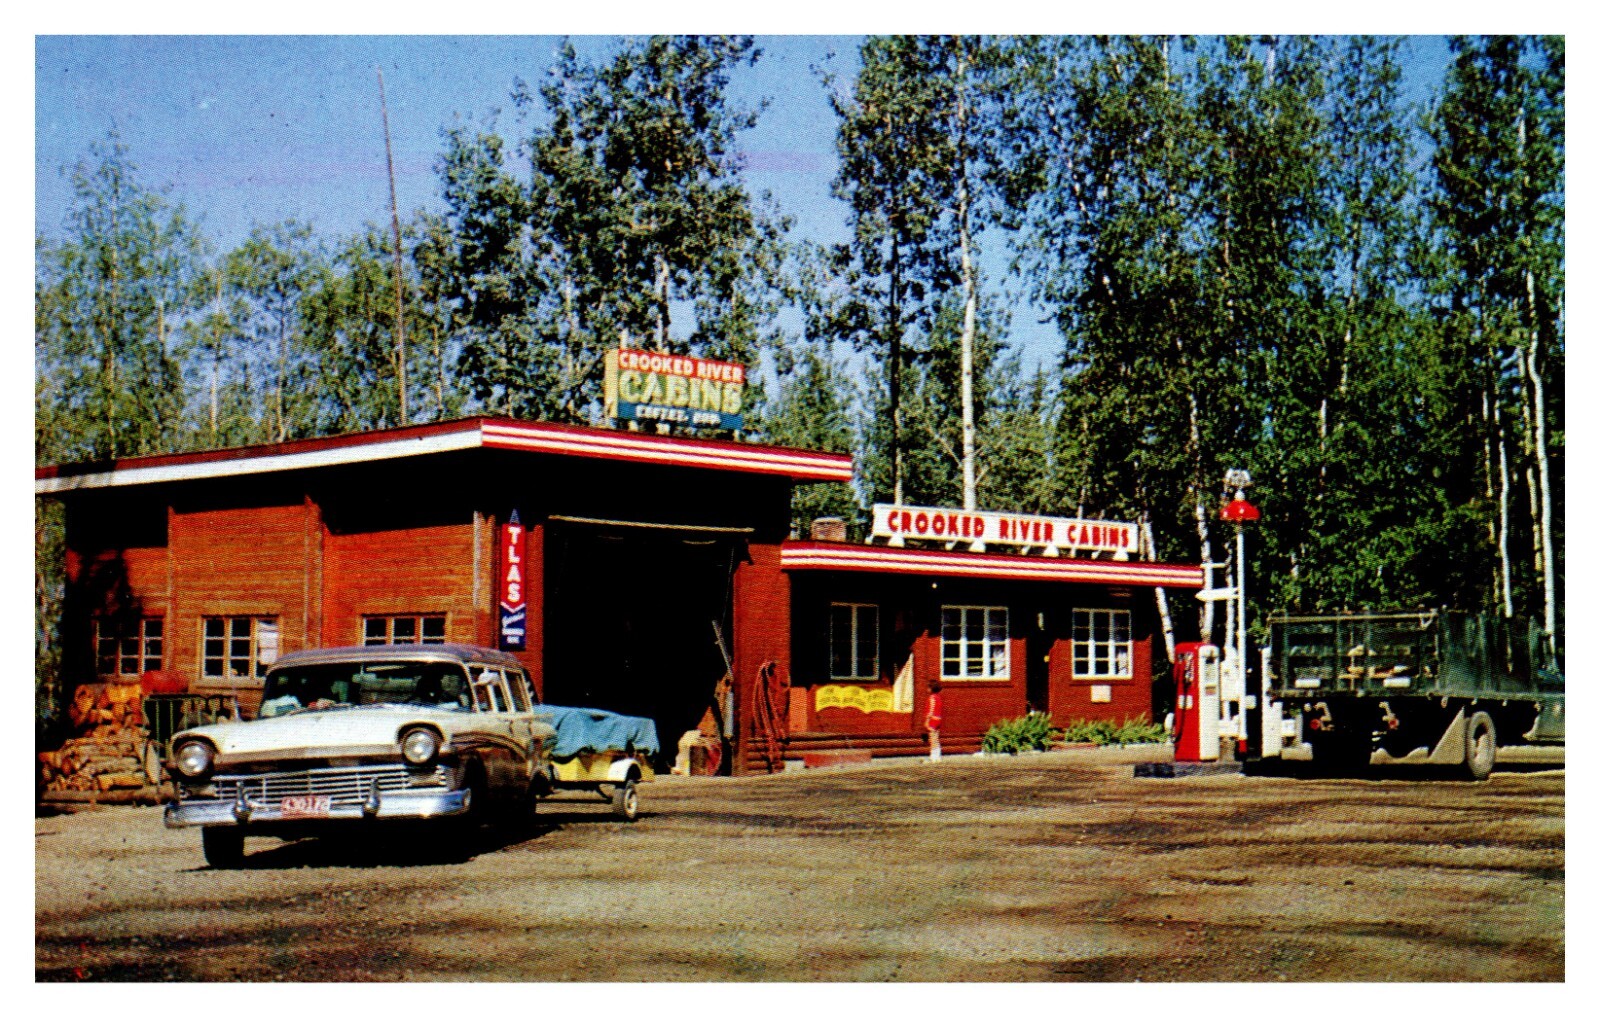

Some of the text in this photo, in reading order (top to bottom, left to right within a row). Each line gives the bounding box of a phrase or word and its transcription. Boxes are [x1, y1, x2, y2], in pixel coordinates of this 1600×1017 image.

[619, 352, 743, 382] CROOKED RIVER
[618, 370, 743, 414] CABINS
[887, 510, 1129, 548] CROOKED RIVER CABINS
[506, 508, 522, 603] ATLAS
